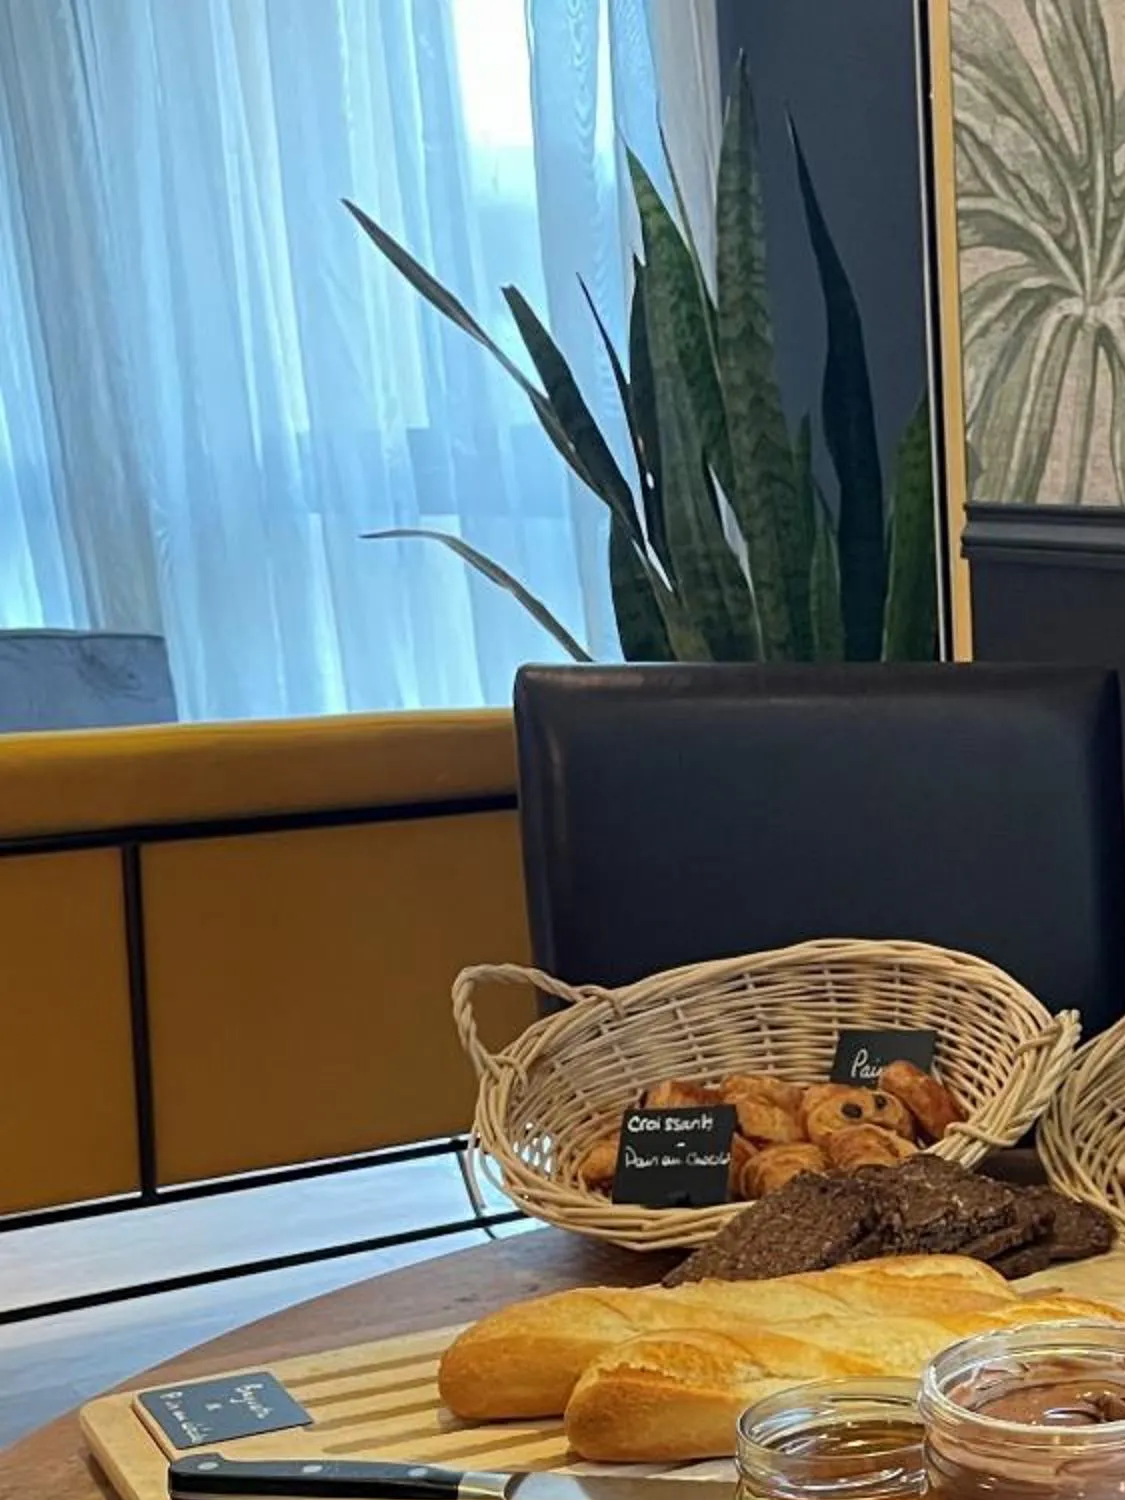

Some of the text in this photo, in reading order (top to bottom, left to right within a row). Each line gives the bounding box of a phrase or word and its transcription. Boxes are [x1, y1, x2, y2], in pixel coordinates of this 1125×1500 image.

[850, 1047, 884, 1078] Pai
[625, 1145, 660, 1169] Pain
[661, 1155, 682, 1168] au
